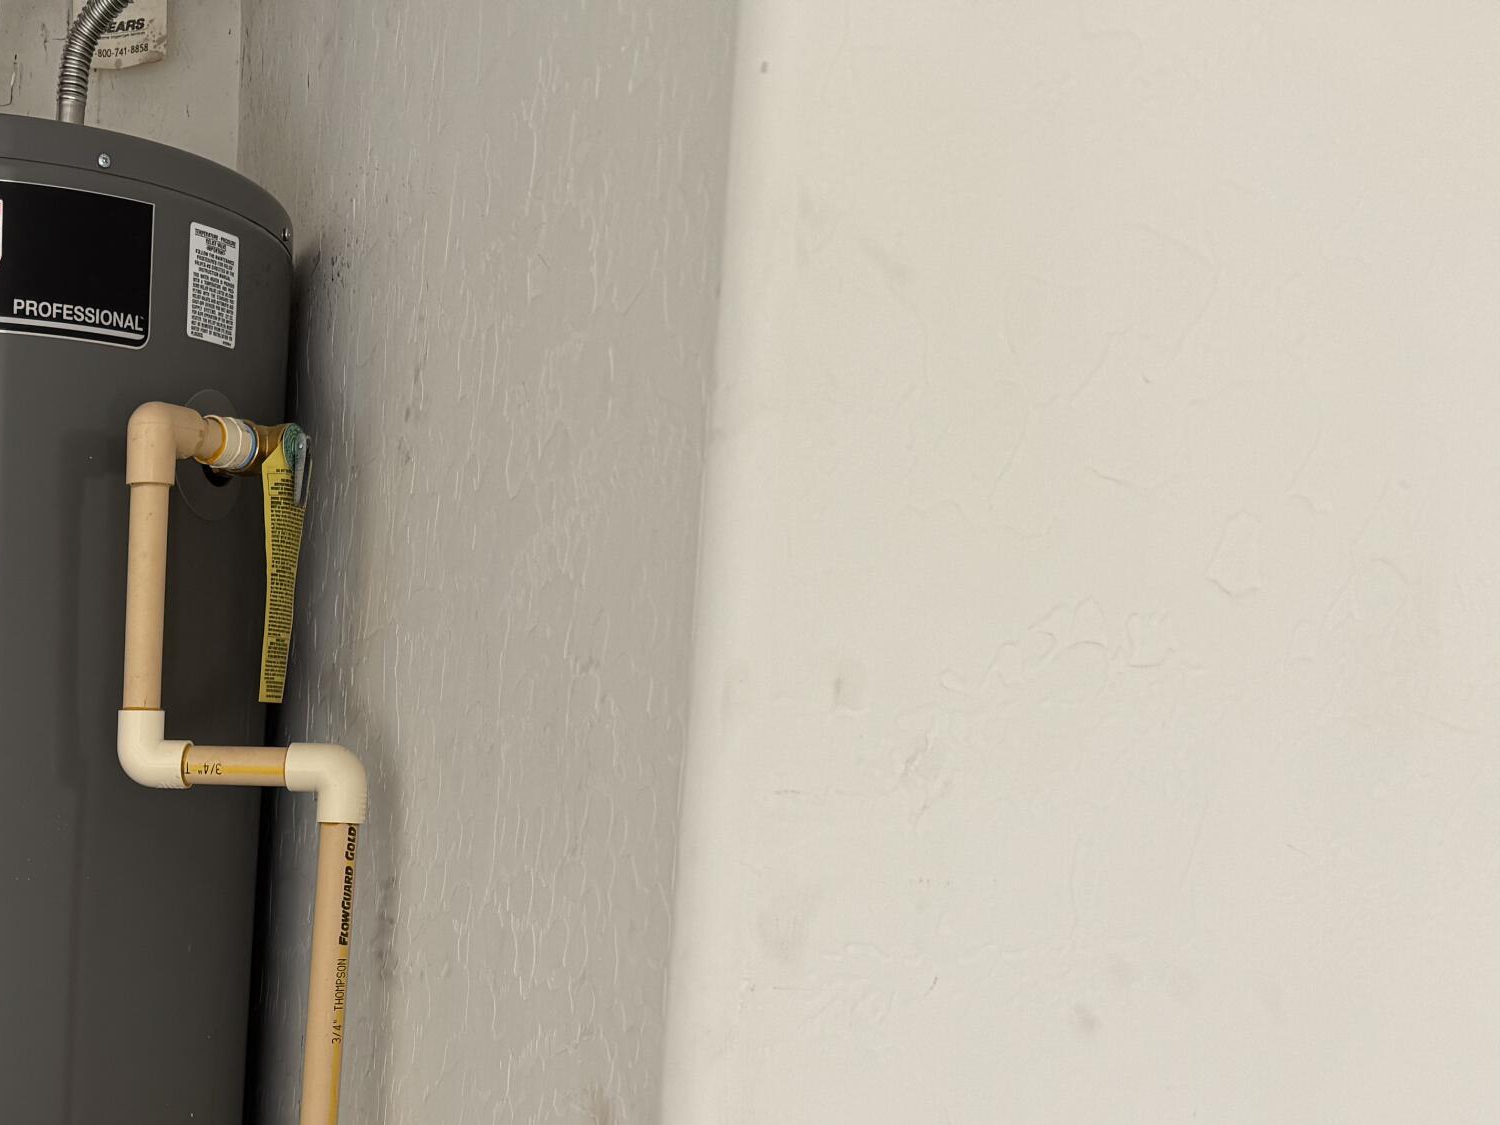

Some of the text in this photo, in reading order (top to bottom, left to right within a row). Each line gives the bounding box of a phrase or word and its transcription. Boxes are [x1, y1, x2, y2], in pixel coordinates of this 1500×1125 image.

[108, 18, 145, 33] EARS
[332, 958, 347, 1044] 3/4" THOMPSON
